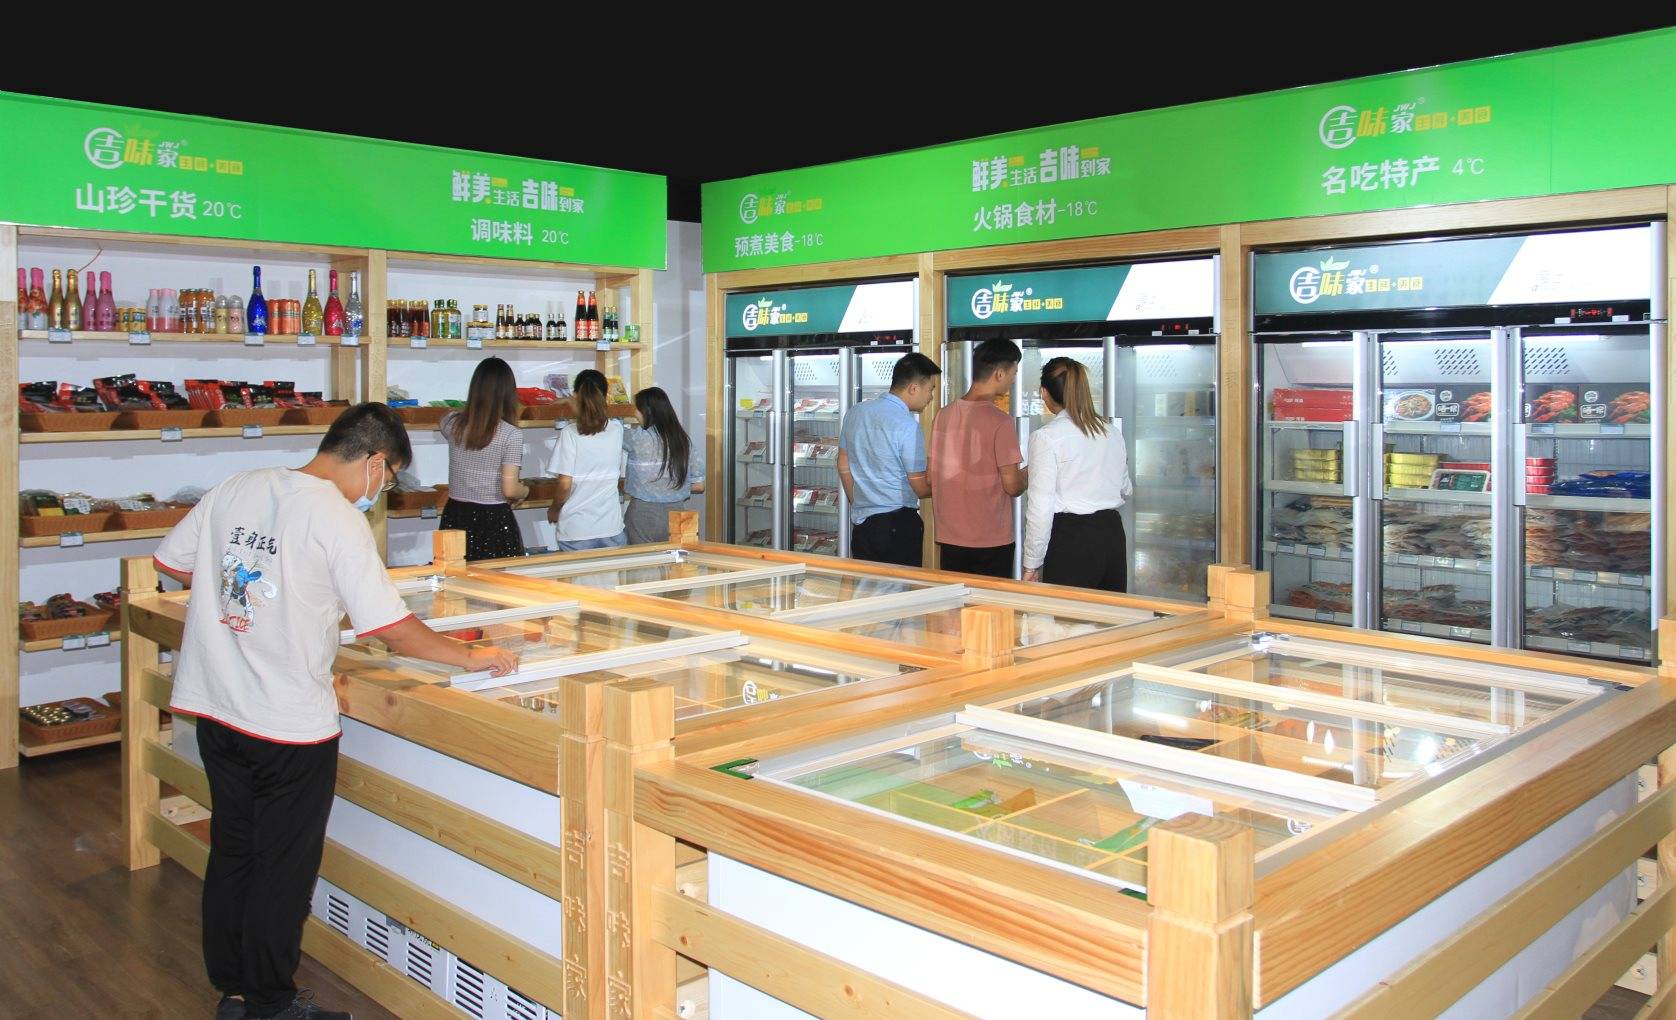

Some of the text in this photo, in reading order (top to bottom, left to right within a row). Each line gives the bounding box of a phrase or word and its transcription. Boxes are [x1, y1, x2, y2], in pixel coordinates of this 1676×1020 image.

[1321, 155, 1440, 196] 名吃特产
[76, 182, 242, 220] 山珍干货 20℃
[973, 199, 1057, 232] 火锅食材
[471, 219, 569, 246] 调味料 20℃
[735, 231, 794, 257] 预煮美食
